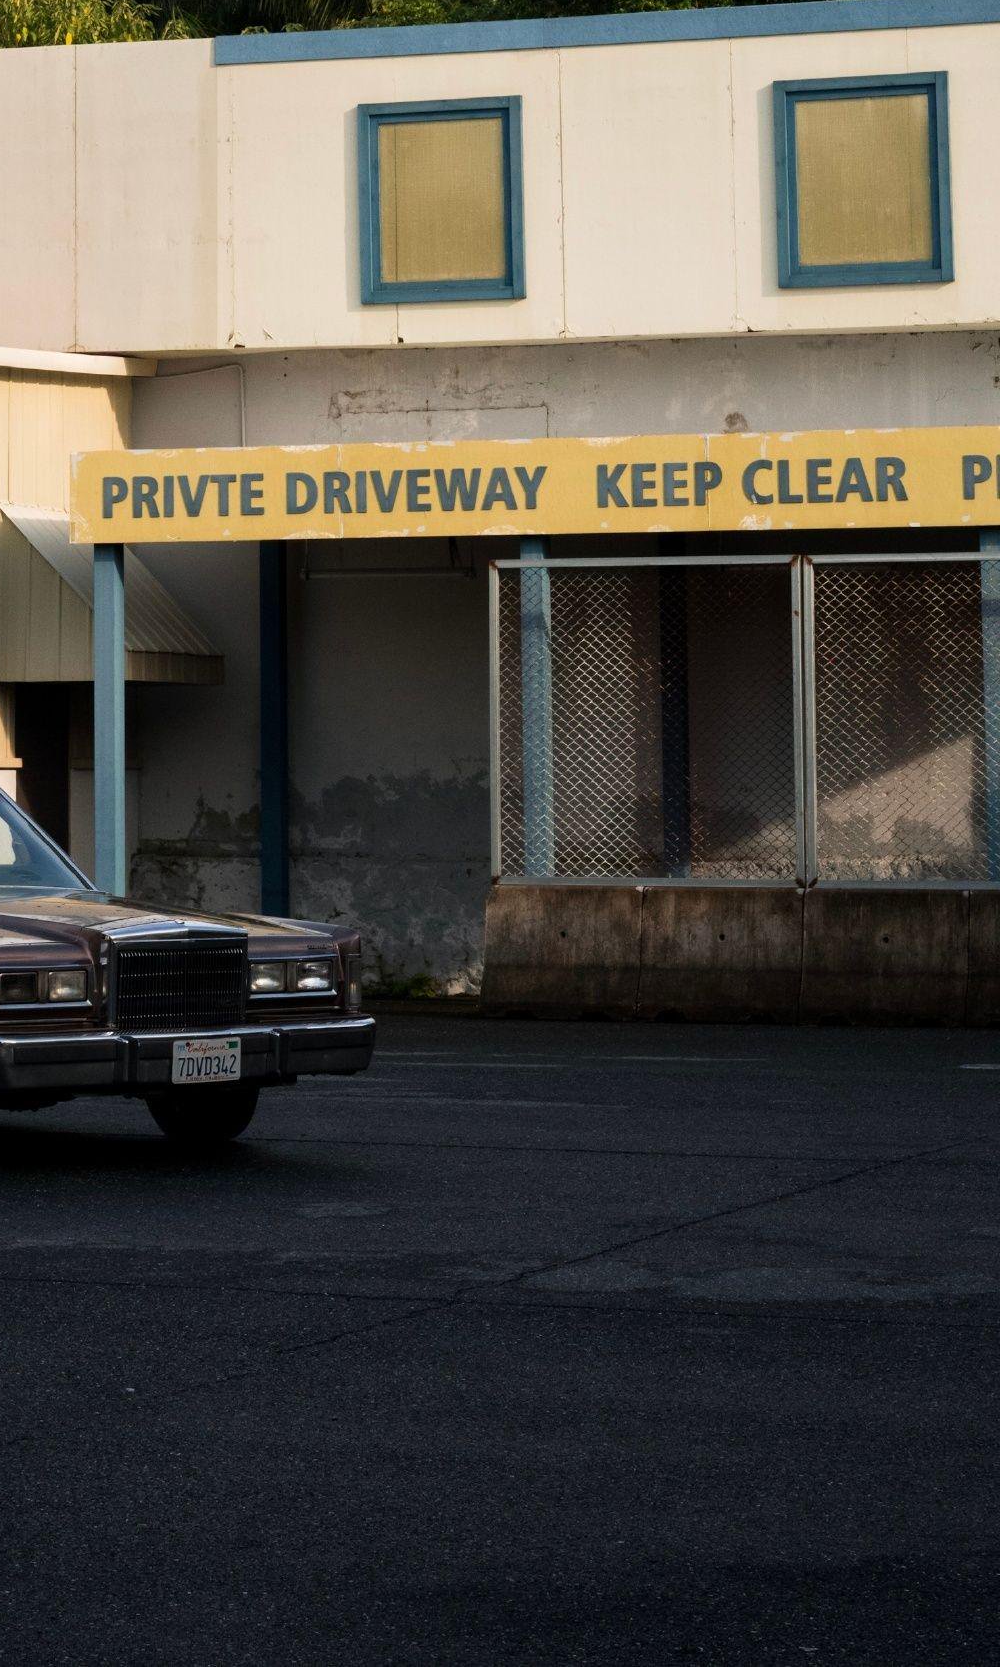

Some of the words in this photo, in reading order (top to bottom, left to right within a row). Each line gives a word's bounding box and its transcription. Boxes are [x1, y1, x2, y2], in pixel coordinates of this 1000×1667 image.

[101, 473, 265, 519] PRIVTE
[285, 465, 547, 515] DRIVEWAY
[596, 461, 723, 508] KEEP
[741, 456, 909, 505] CLEAR
[962, 454, 1000, 501] P
[178, 1054, 237, 1076] 7DVD342
